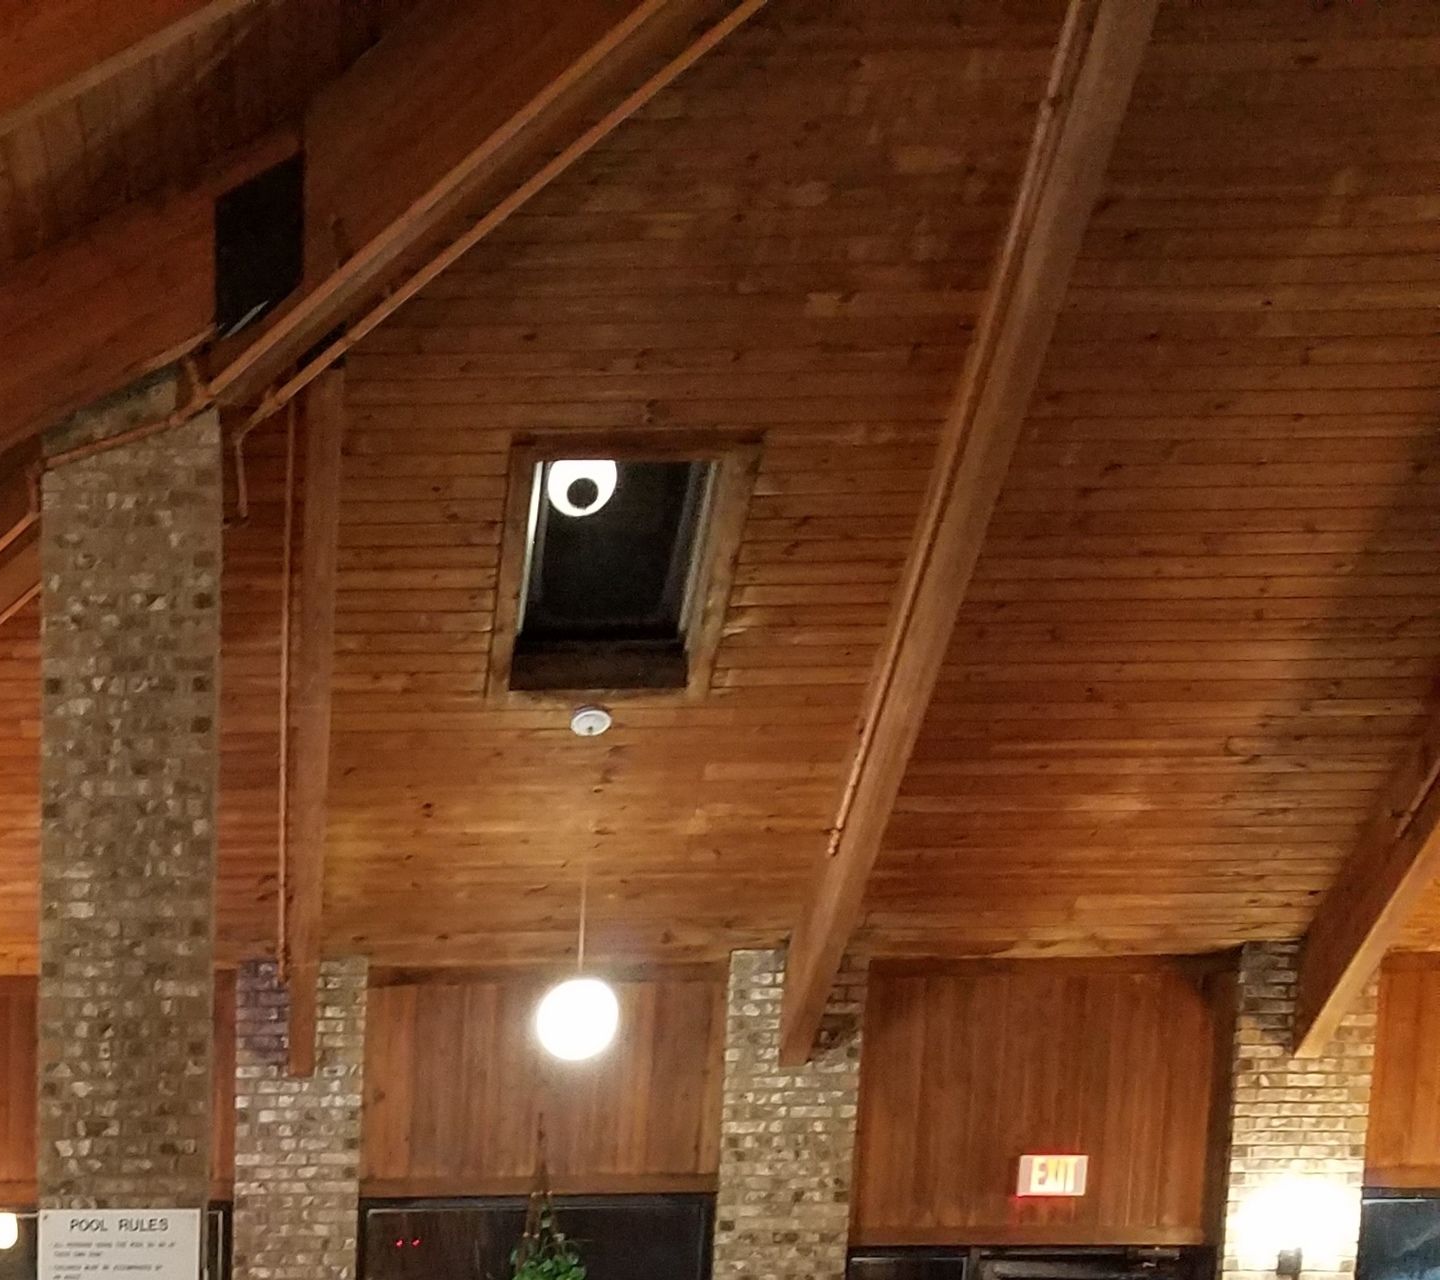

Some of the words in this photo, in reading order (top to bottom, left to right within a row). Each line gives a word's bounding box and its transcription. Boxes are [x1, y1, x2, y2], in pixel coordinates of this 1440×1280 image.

[1031, 1157, 1077, 1193] EXIT
[70, 1218, 108, 1232] POOL
[118, 1218, 169, 1232] RULES
